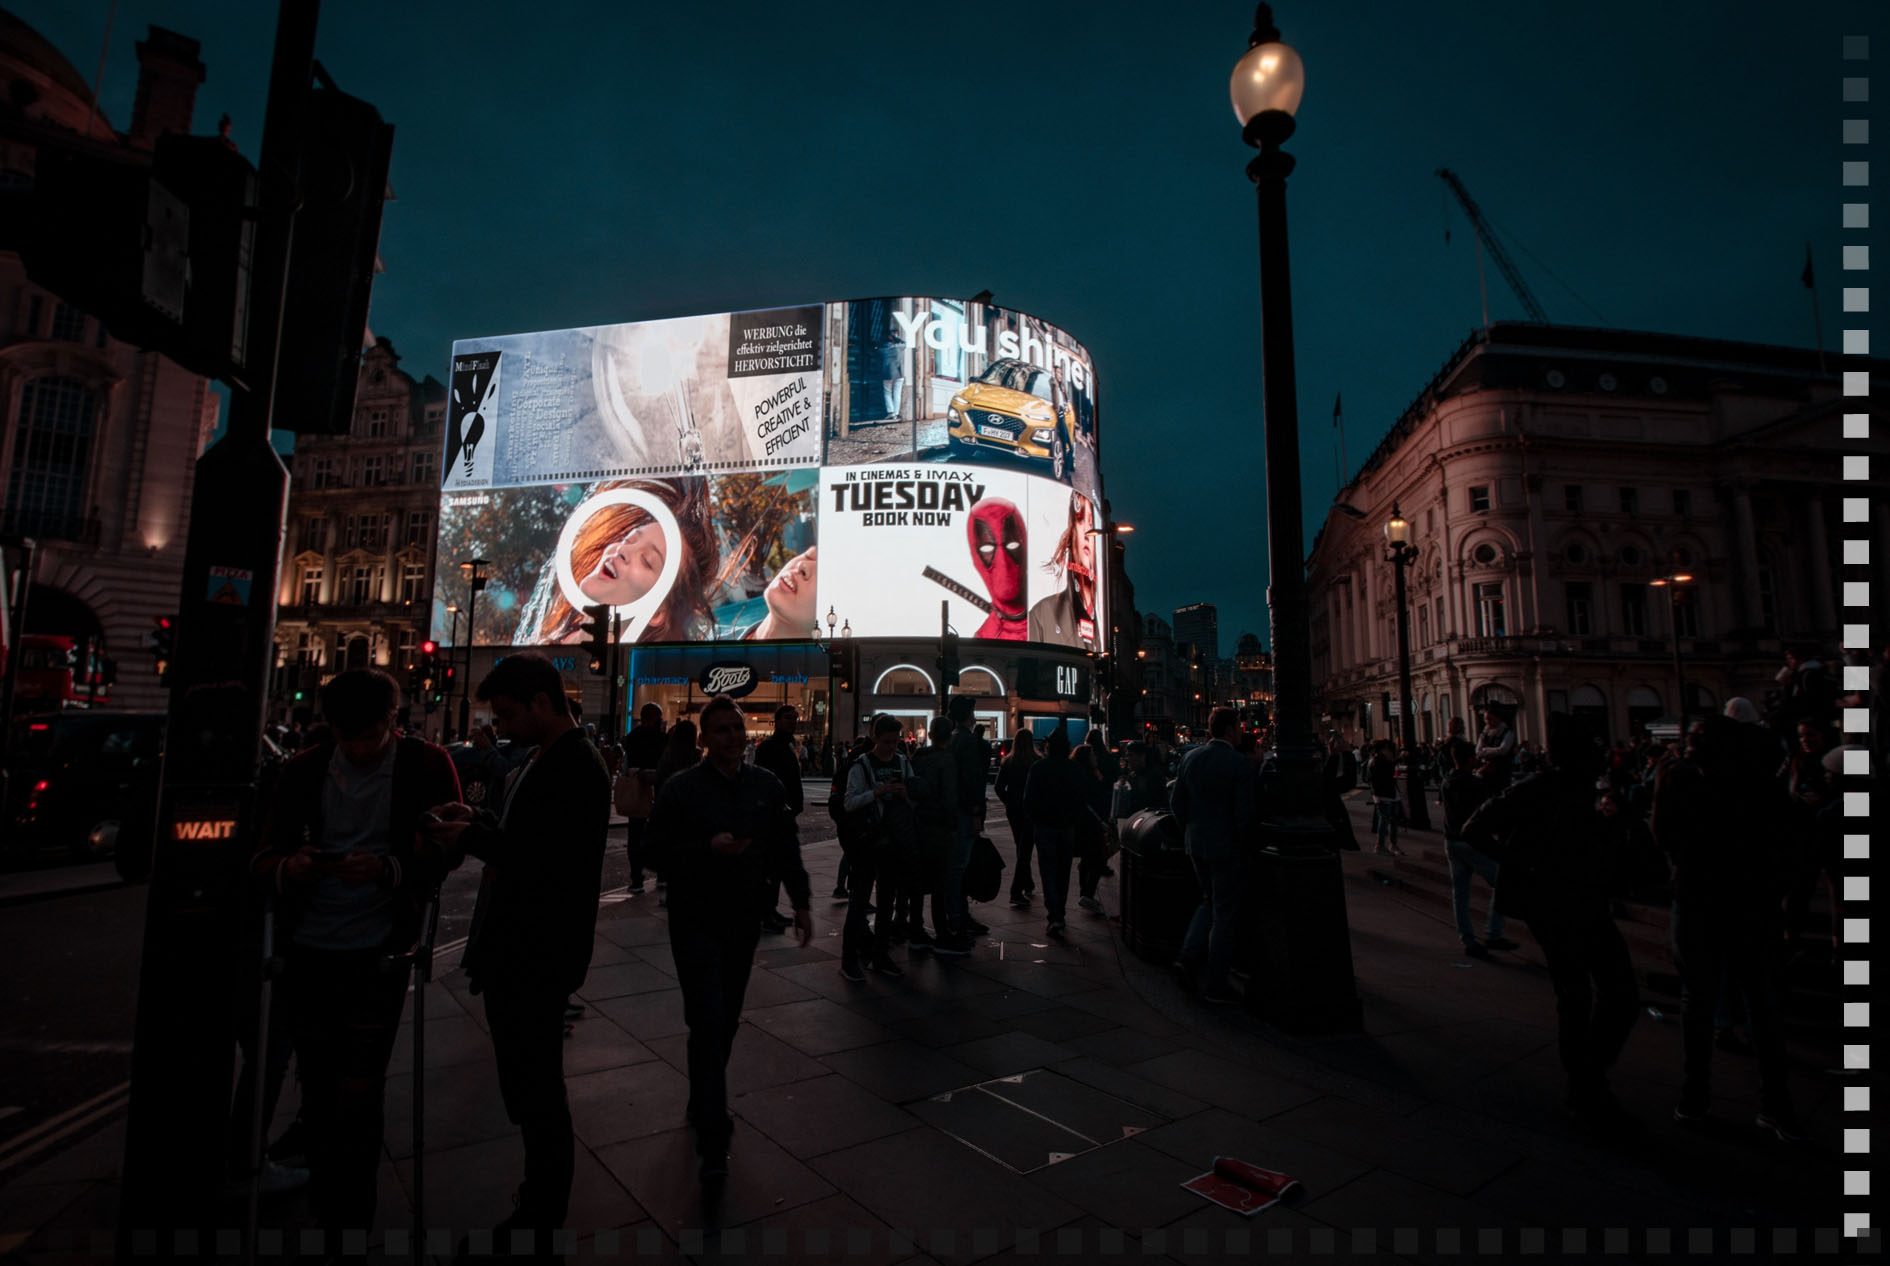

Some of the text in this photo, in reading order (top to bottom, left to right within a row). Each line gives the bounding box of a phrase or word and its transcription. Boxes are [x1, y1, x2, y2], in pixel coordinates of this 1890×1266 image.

[743, 324, 807, 341] WERBUNG die
[892, 311, 987, 354] You
[736, 338, 813, 355] effektiv zielgerichtet
[734, 354, 814, 373] HERVORSTICHT!
[517, 397, 560, 412] Corporate
[754, 376, 807, 420] POWERFUL
[536, 407, 567, 422] Design
[757, 396, 812, 439] CREATIVE &
[765, 416, 810, 457] EFFICIENT
[845, 470, 974, 482] IN CINEMAS & IMAX
[449, 496, 490, 506] SAMSUNG
[830, 481, 986, 512] TUESDAY
[862, 511, 952, 527] BOOK NOW
[637, 675, 689, 687] pharmacy
[703, 666, 751, 693] Boots
[770, 672, 809, 685] beauty
[1056, 664, 1078, 696] GAP
[175, 820, 236, 840] WAIT
